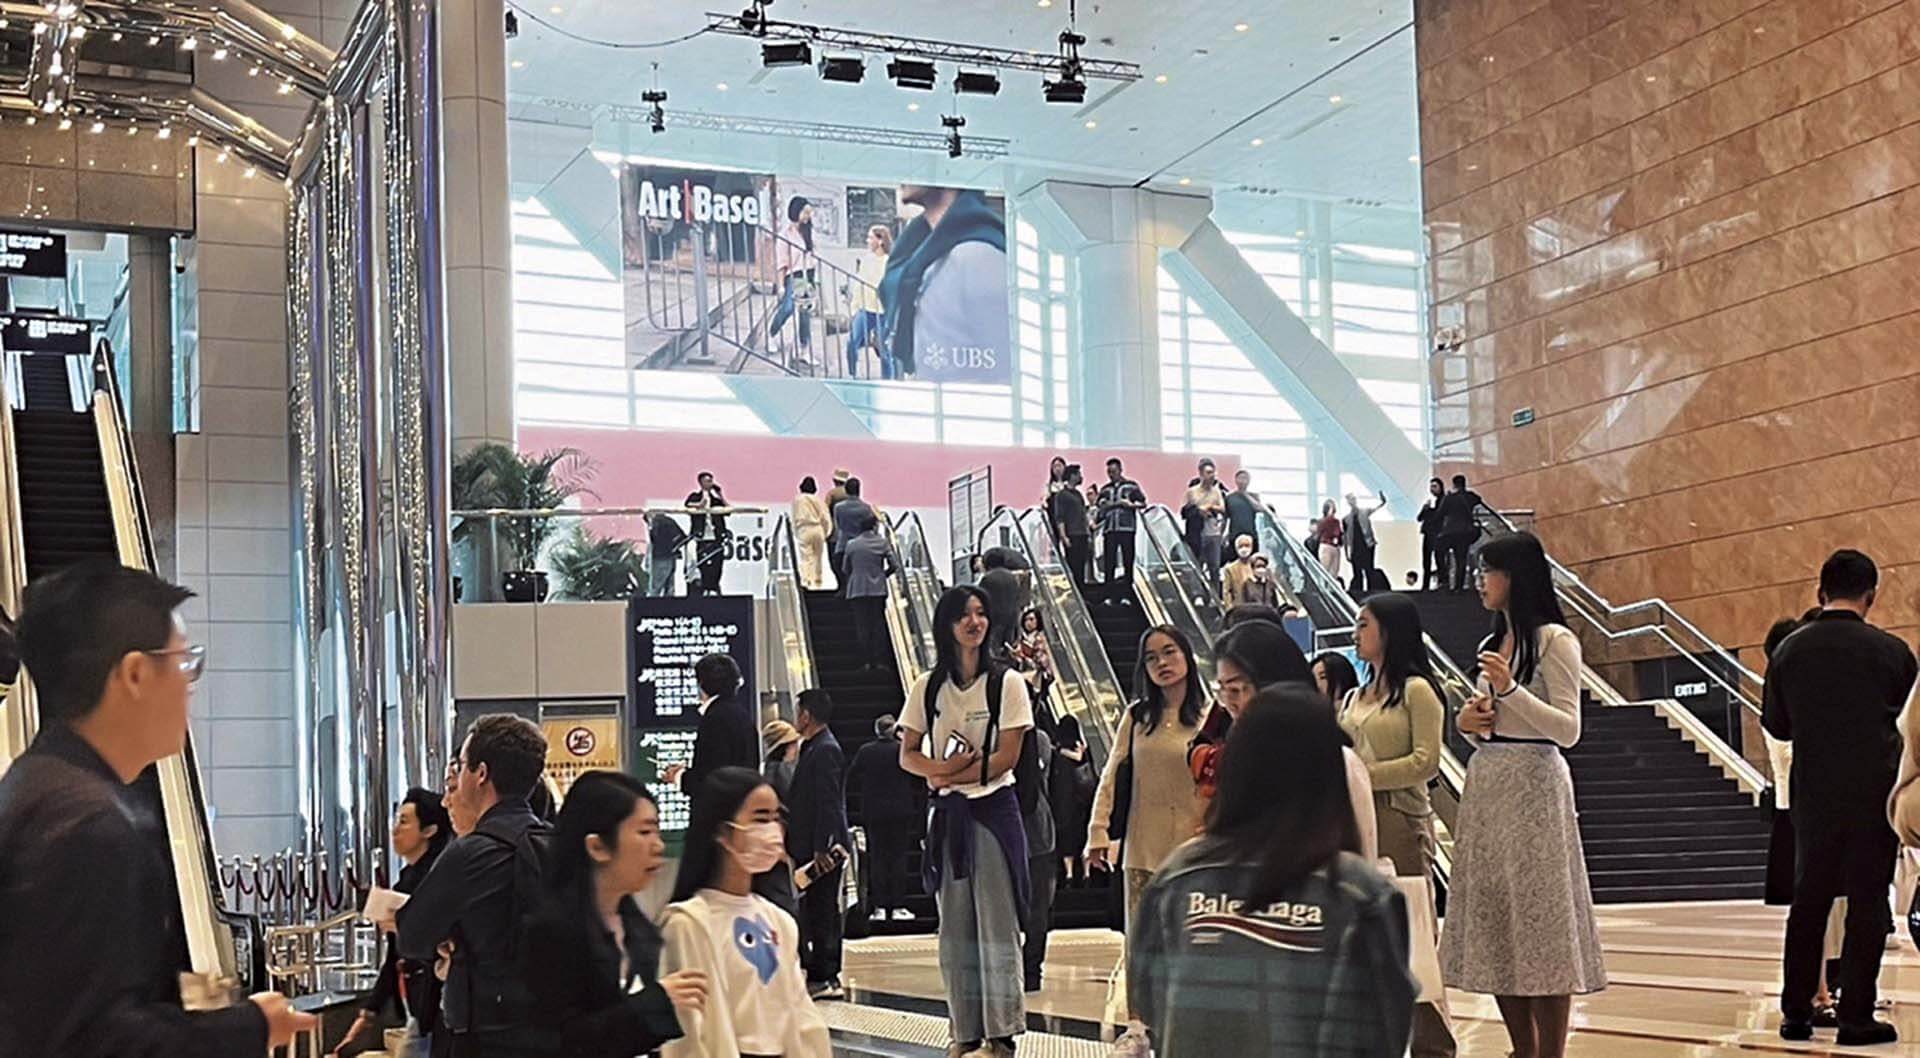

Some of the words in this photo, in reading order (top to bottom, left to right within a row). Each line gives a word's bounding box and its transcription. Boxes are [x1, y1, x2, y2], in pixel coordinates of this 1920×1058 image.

[638, 180, 682, 219] Art
[692, 185, 769, 225] Basel
[952, 346, 996, 368] UBS
[721, 529, 771, 561] Bas
[1187, 892, 1322, 926] Baleiaga
